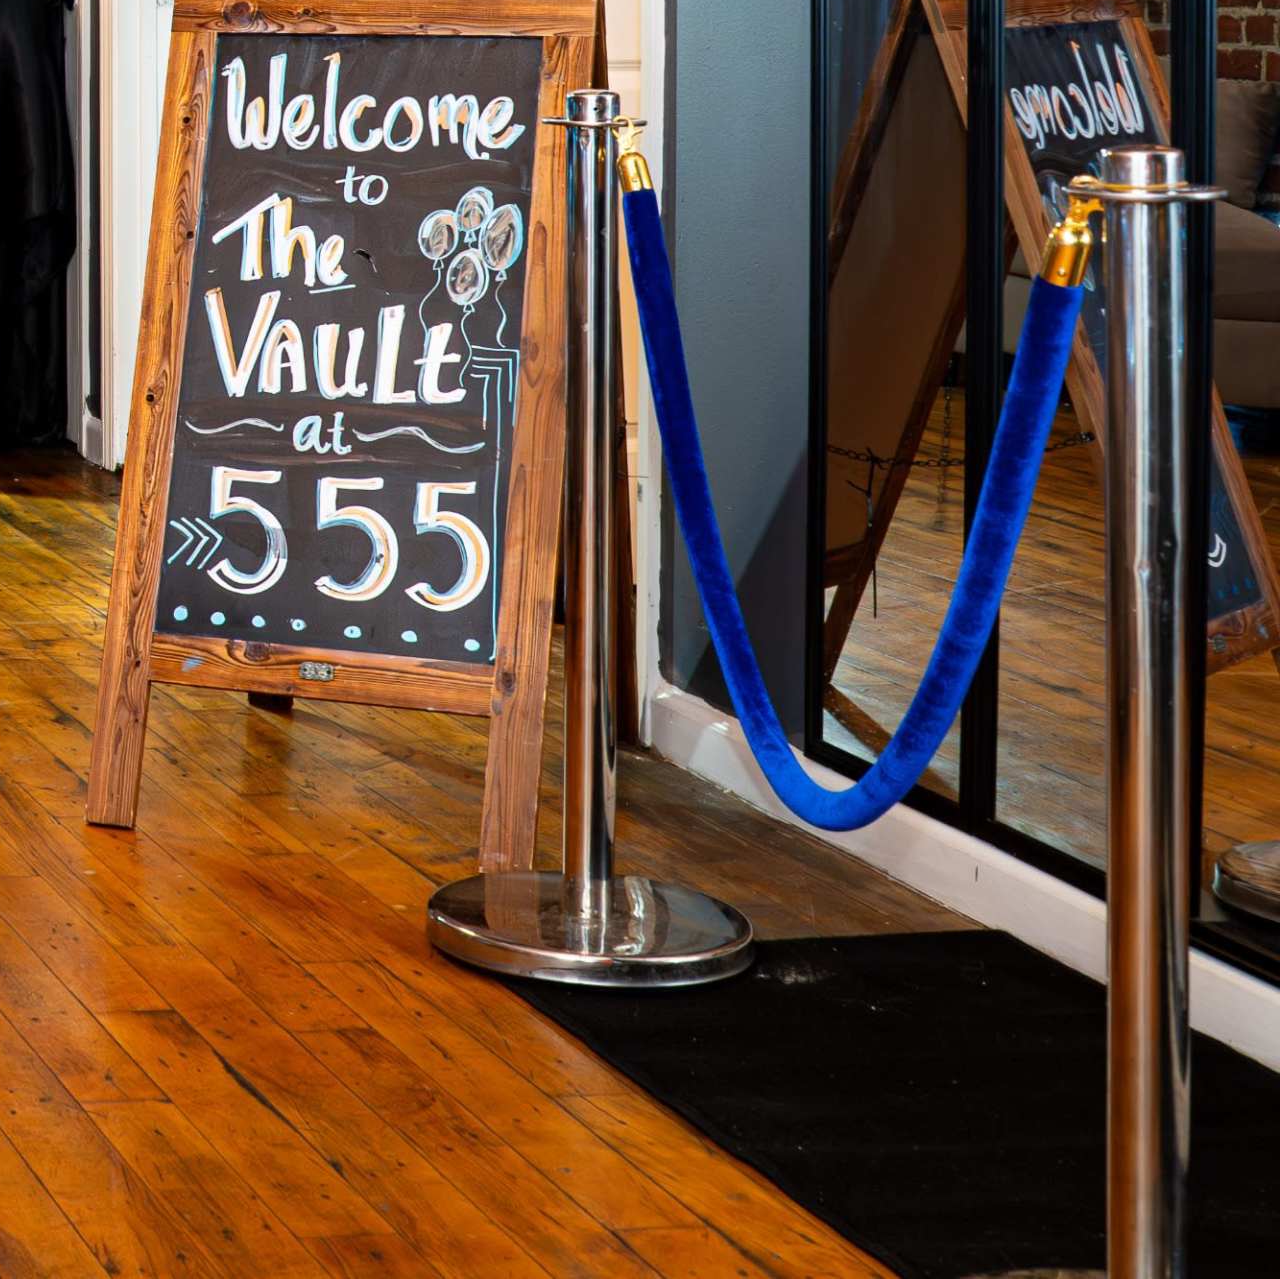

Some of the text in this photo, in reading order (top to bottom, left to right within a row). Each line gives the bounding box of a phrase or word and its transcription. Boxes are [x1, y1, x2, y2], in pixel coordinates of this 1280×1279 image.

[221, 52, 525, 159] Welcome
[335, 165, 389, 205] to
[211, 193, 349, 287] The
[291, 411, 353, 455] at
[207, 466, 491, 612] 555
